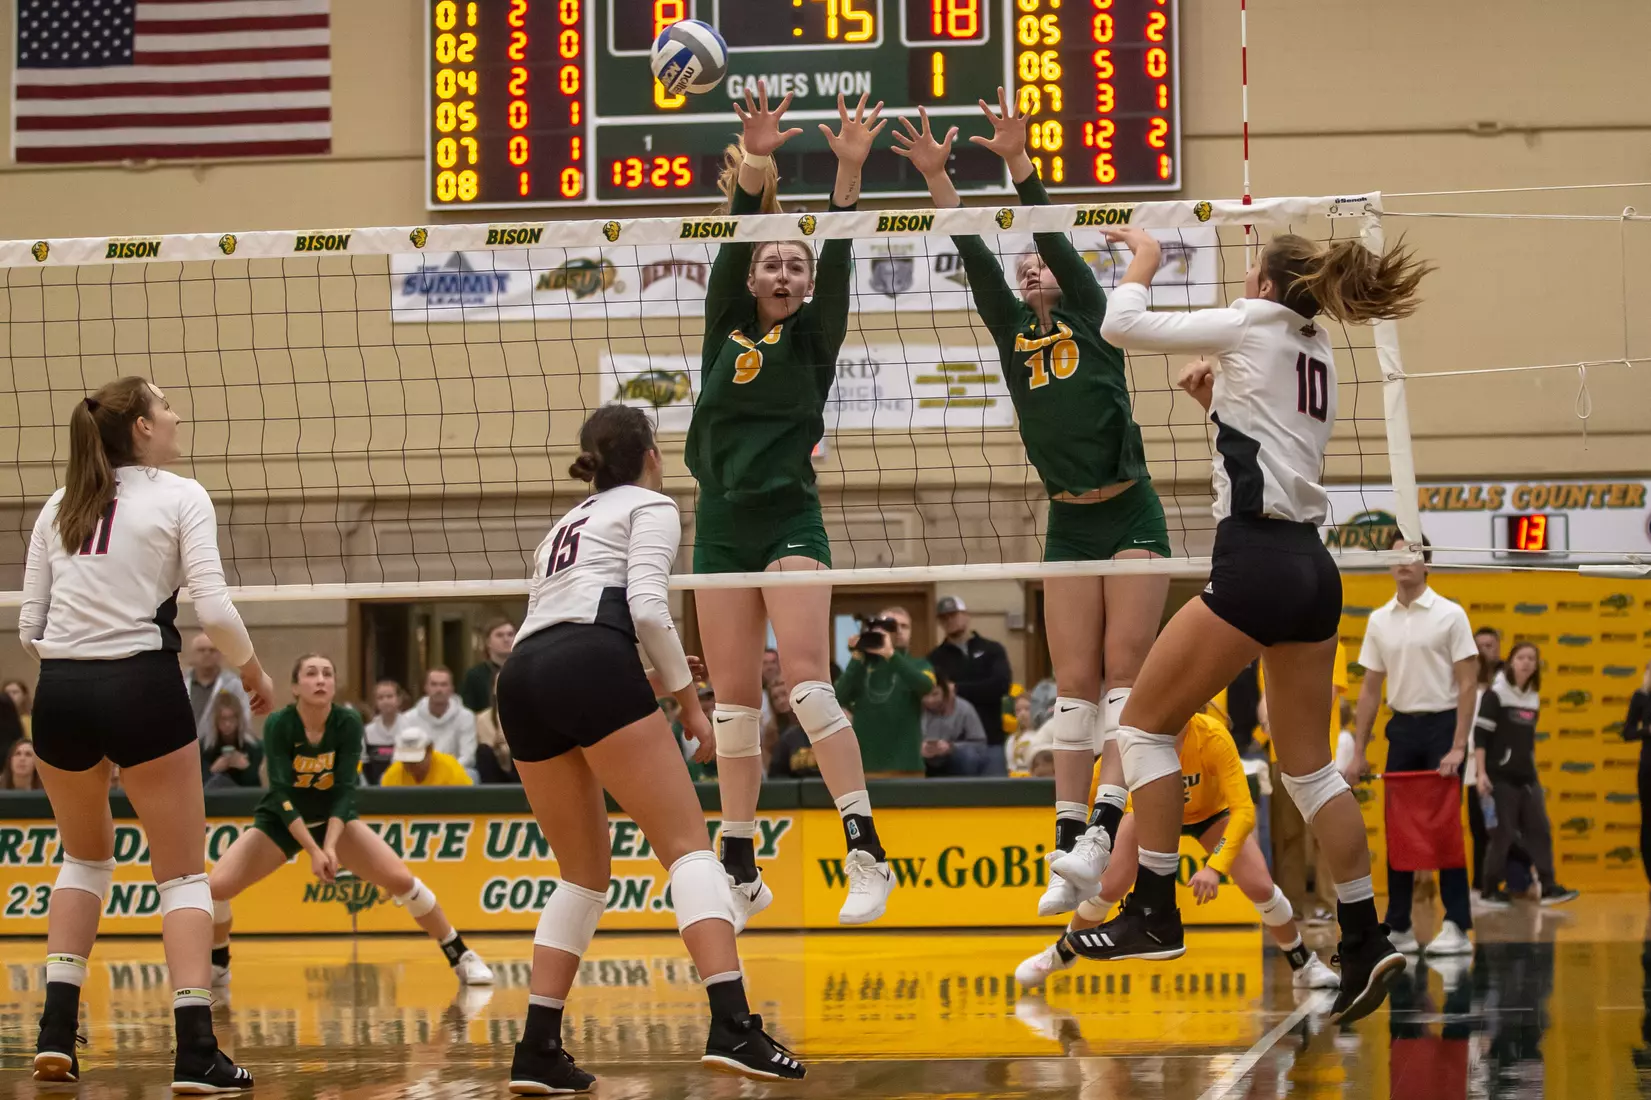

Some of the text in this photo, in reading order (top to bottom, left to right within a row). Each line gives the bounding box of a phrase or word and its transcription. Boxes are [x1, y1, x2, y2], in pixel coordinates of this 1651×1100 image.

[436, 0, 580, 29] 01 2 0
[1017, 11, 1167, 46] 05 0 2
[436, 29, 581, 63] 02 2 0
[673, 66, 694, 94] molte
[932, 51, 944, 97] 1
[1017, 48, 1167, 81] 06 5 0
[436, 64, 581, 99] 04 2 0
[728, 71, 872, 99] GAMES WON
[1019, 83, 1167, 115] 07 3 1
[436, 99, 581, 132] 05 0 1
[1030, 117, 1169, 151] 10 12 2
[436, 135, 581, 168] 07 0 1
[1095, 152, 1117, 183] 6
[1158, 154, 1170, 180] 1
[436, 167, 582, 201] 08 1 0
[680, 221, 738, 239] BISON
[876, 214, 935, 232] BISON
[1073, 208, 1133, 226] BISON
[105, 241, 161, 259] BISON
[294, 234, 351, 252] BISON
[486, 227, 543, 245] BISON
[402, 273, 510, 296] SUMMIT
[642, 260, 707, 292] DENVER
[732, 348, 764, 384] 9
[1024, 339, 1080, 390] 10
[1296, 351, 1328, 421] 10
[1417, 483, 1646, 511] KILLS COUNTER
[545, 515, 591, 578] 15
[1326, 526, 1394, 550] NDSU
[1517, 514, 1546, 550] 13
[303, 881, 372, 905] NDSU
